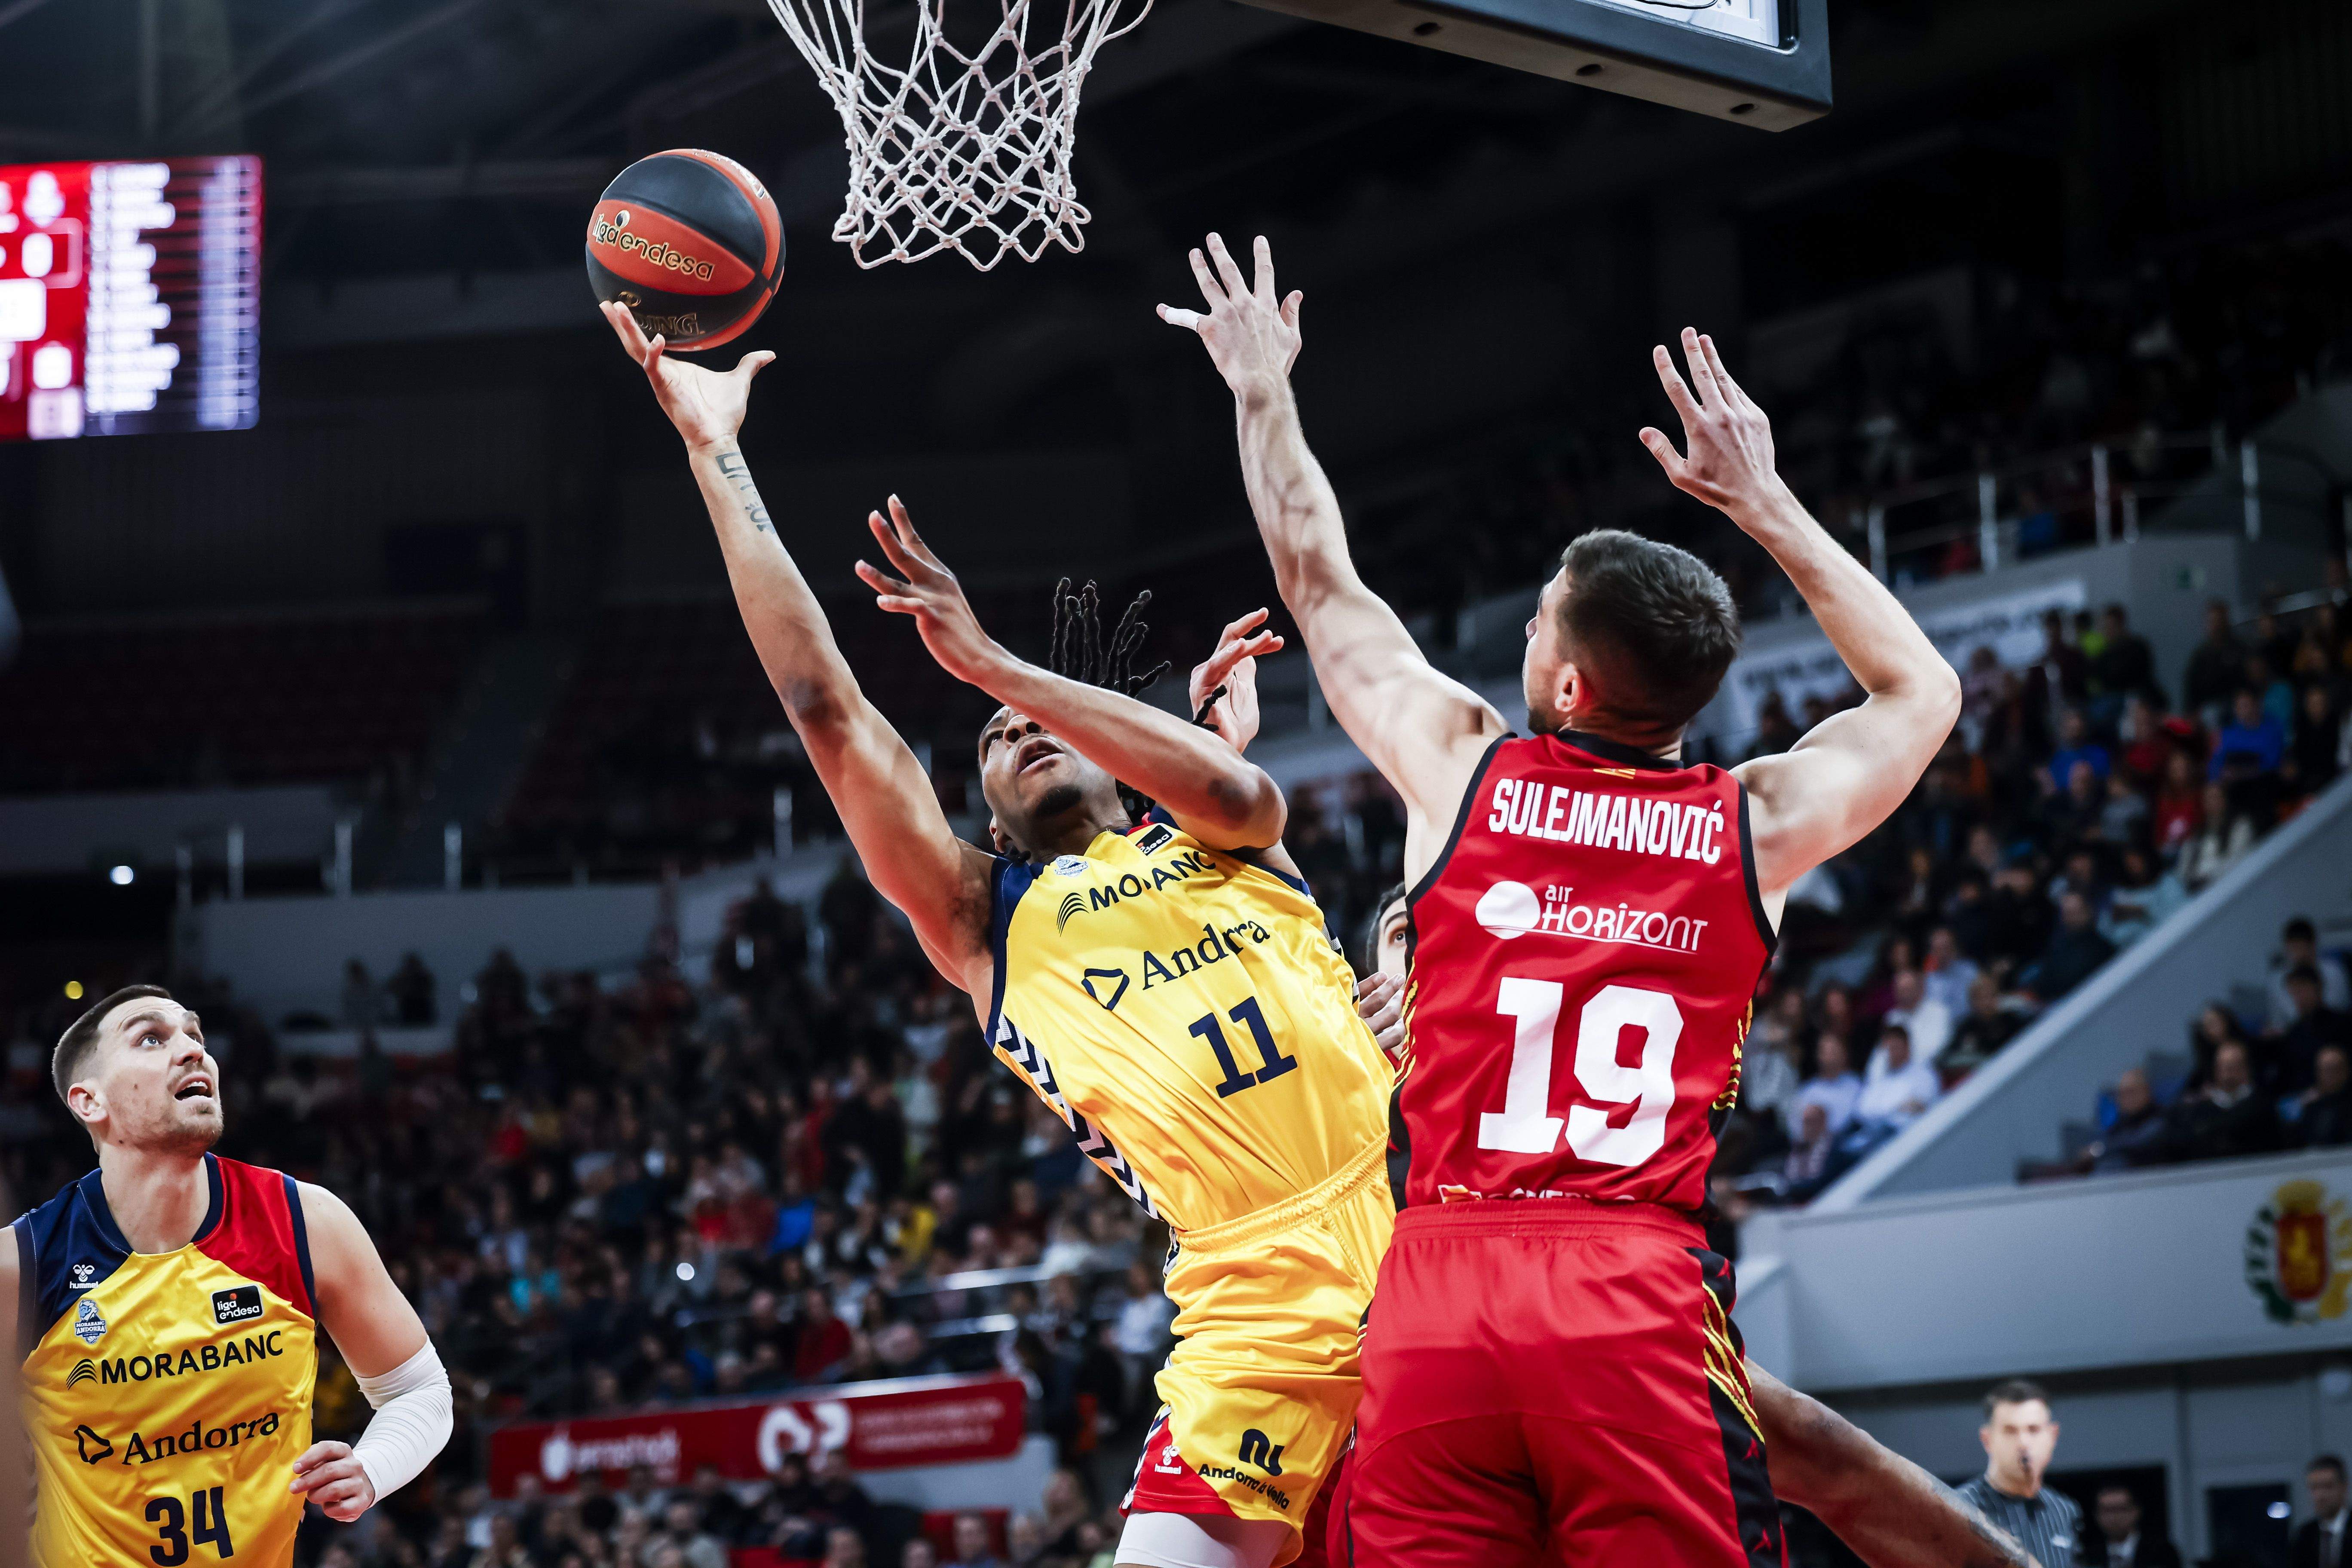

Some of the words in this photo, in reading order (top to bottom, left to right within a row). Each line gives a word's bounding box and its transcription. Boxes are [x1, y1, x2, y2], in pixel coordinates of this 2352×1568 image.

[619, 232, 715, 282] endesa
[1488, 778, 1724, 865] SULEJMANOVIĆ
[1188, 996, 1298, 1098] 11
[1478, 977, 1684, 1167] 19
[77, 1325, 105, 1334] ANDORRA
[217, 1301, 237, 1311] liga
[219, 1305, 260, 1320] endesa
[101, 1331, 284, 1384] MORABANC
[122, 1412, 279, 1465] Andorra
[1155, 1463, 1182, 1474] hummel
[1197, 1464, 1260, 1490] Andorra
[145, 1486, 234, 1568] 34
